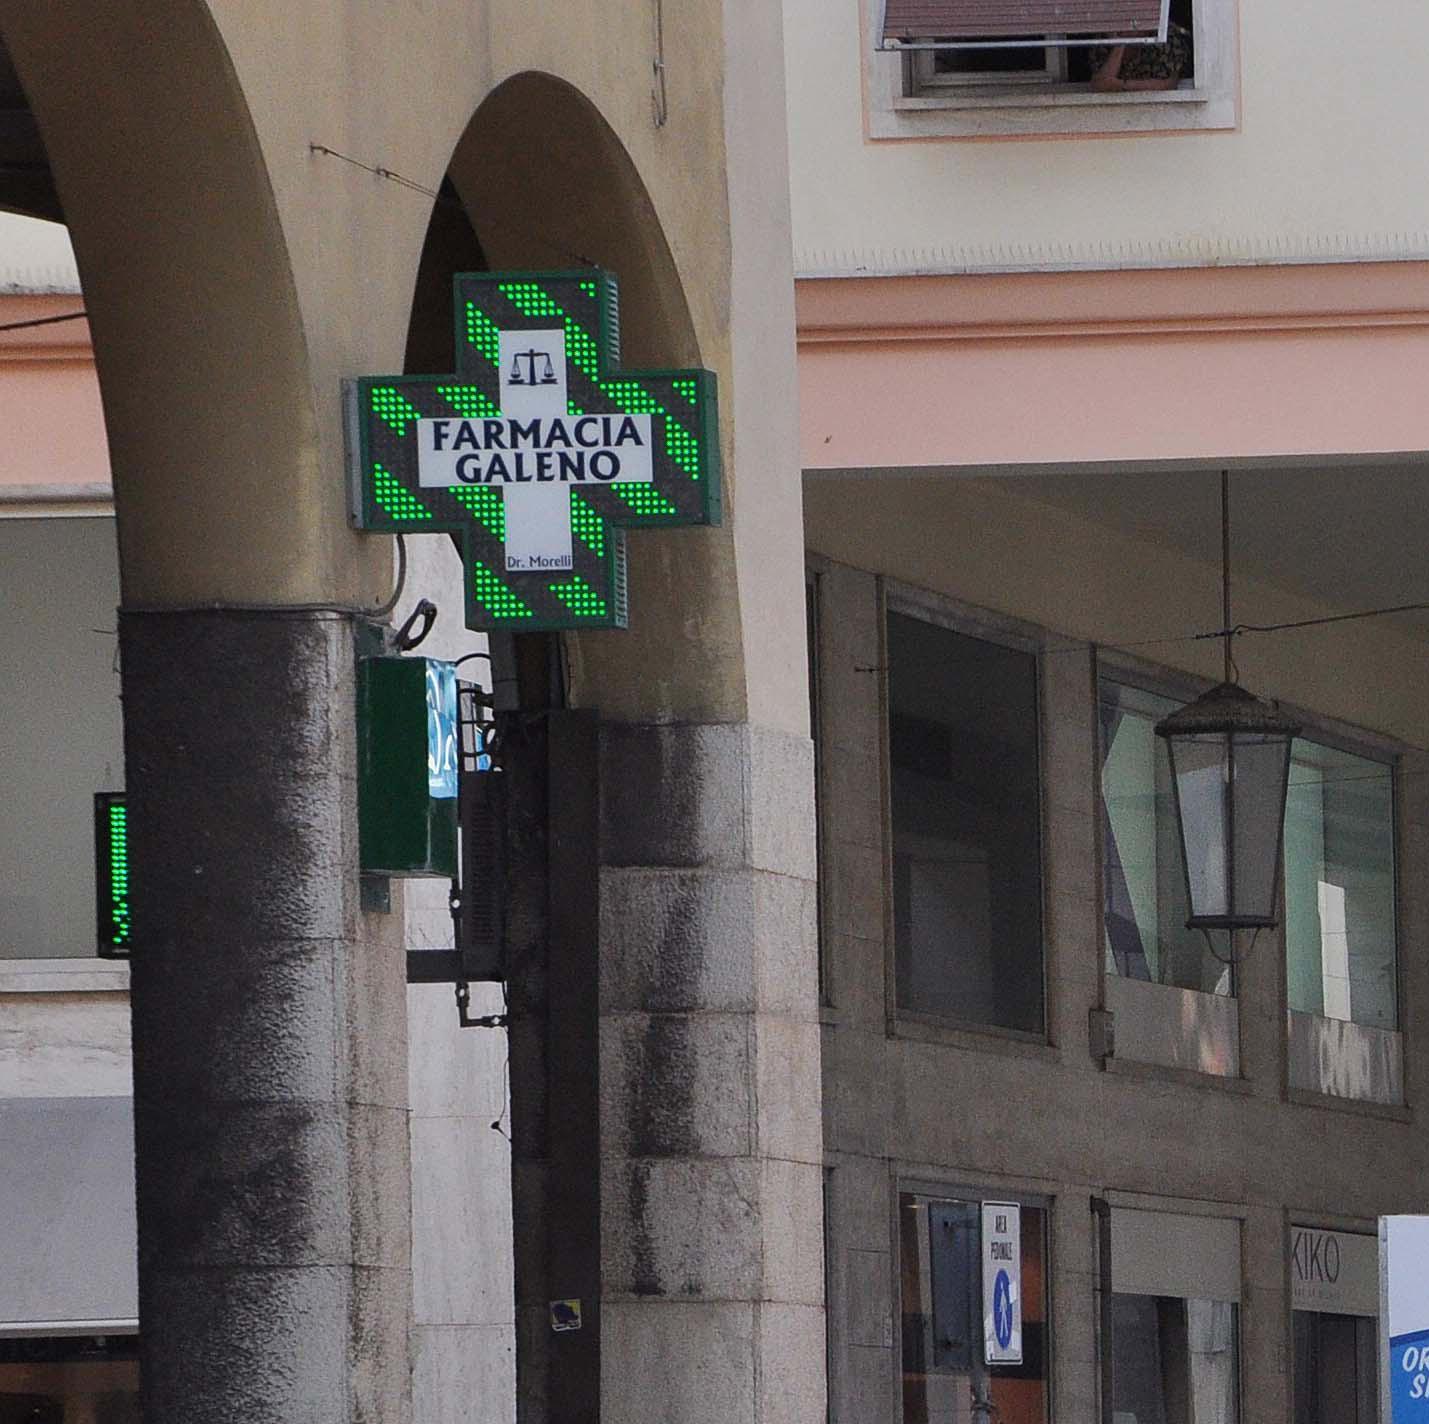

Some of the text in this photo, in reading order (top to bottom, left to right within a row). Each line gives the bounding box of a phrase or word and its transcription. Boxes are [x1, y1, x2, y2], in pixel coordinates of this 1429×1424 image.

[432, 416, 645, 452] FARMACIA
[455, 450, 621, 484] GALENO
[507, 554, 572, 568] Dr. Morelli
